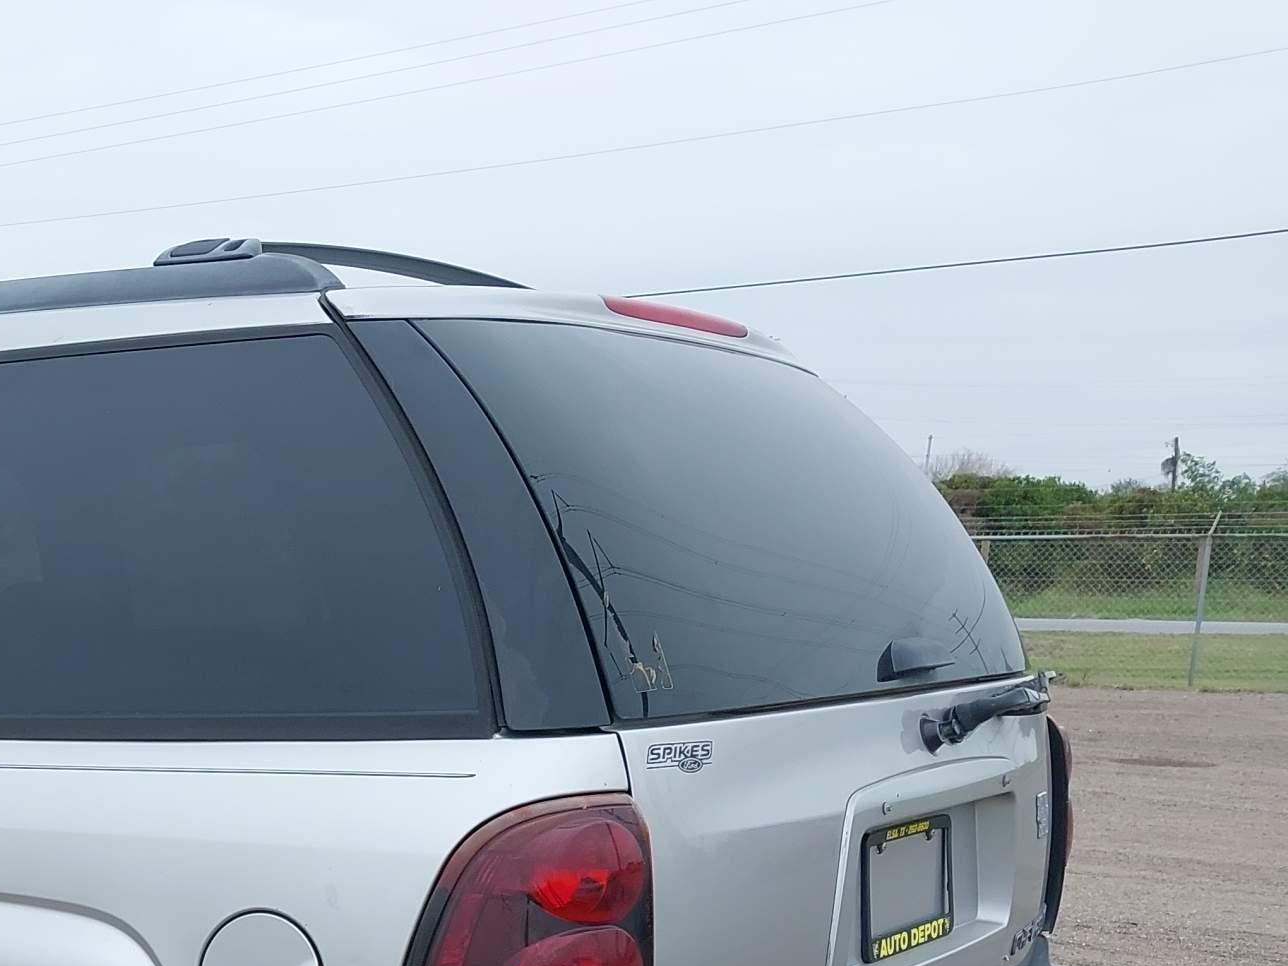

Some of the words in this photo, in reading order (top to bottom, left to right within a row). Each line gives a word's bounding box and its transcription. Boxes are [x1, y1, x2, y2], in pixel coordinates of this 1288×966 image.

[648, 743, 711, 761] SPIKES
[879, 931, 909, 958] AUTO
[910, 918, 945, 947] DEPOT
